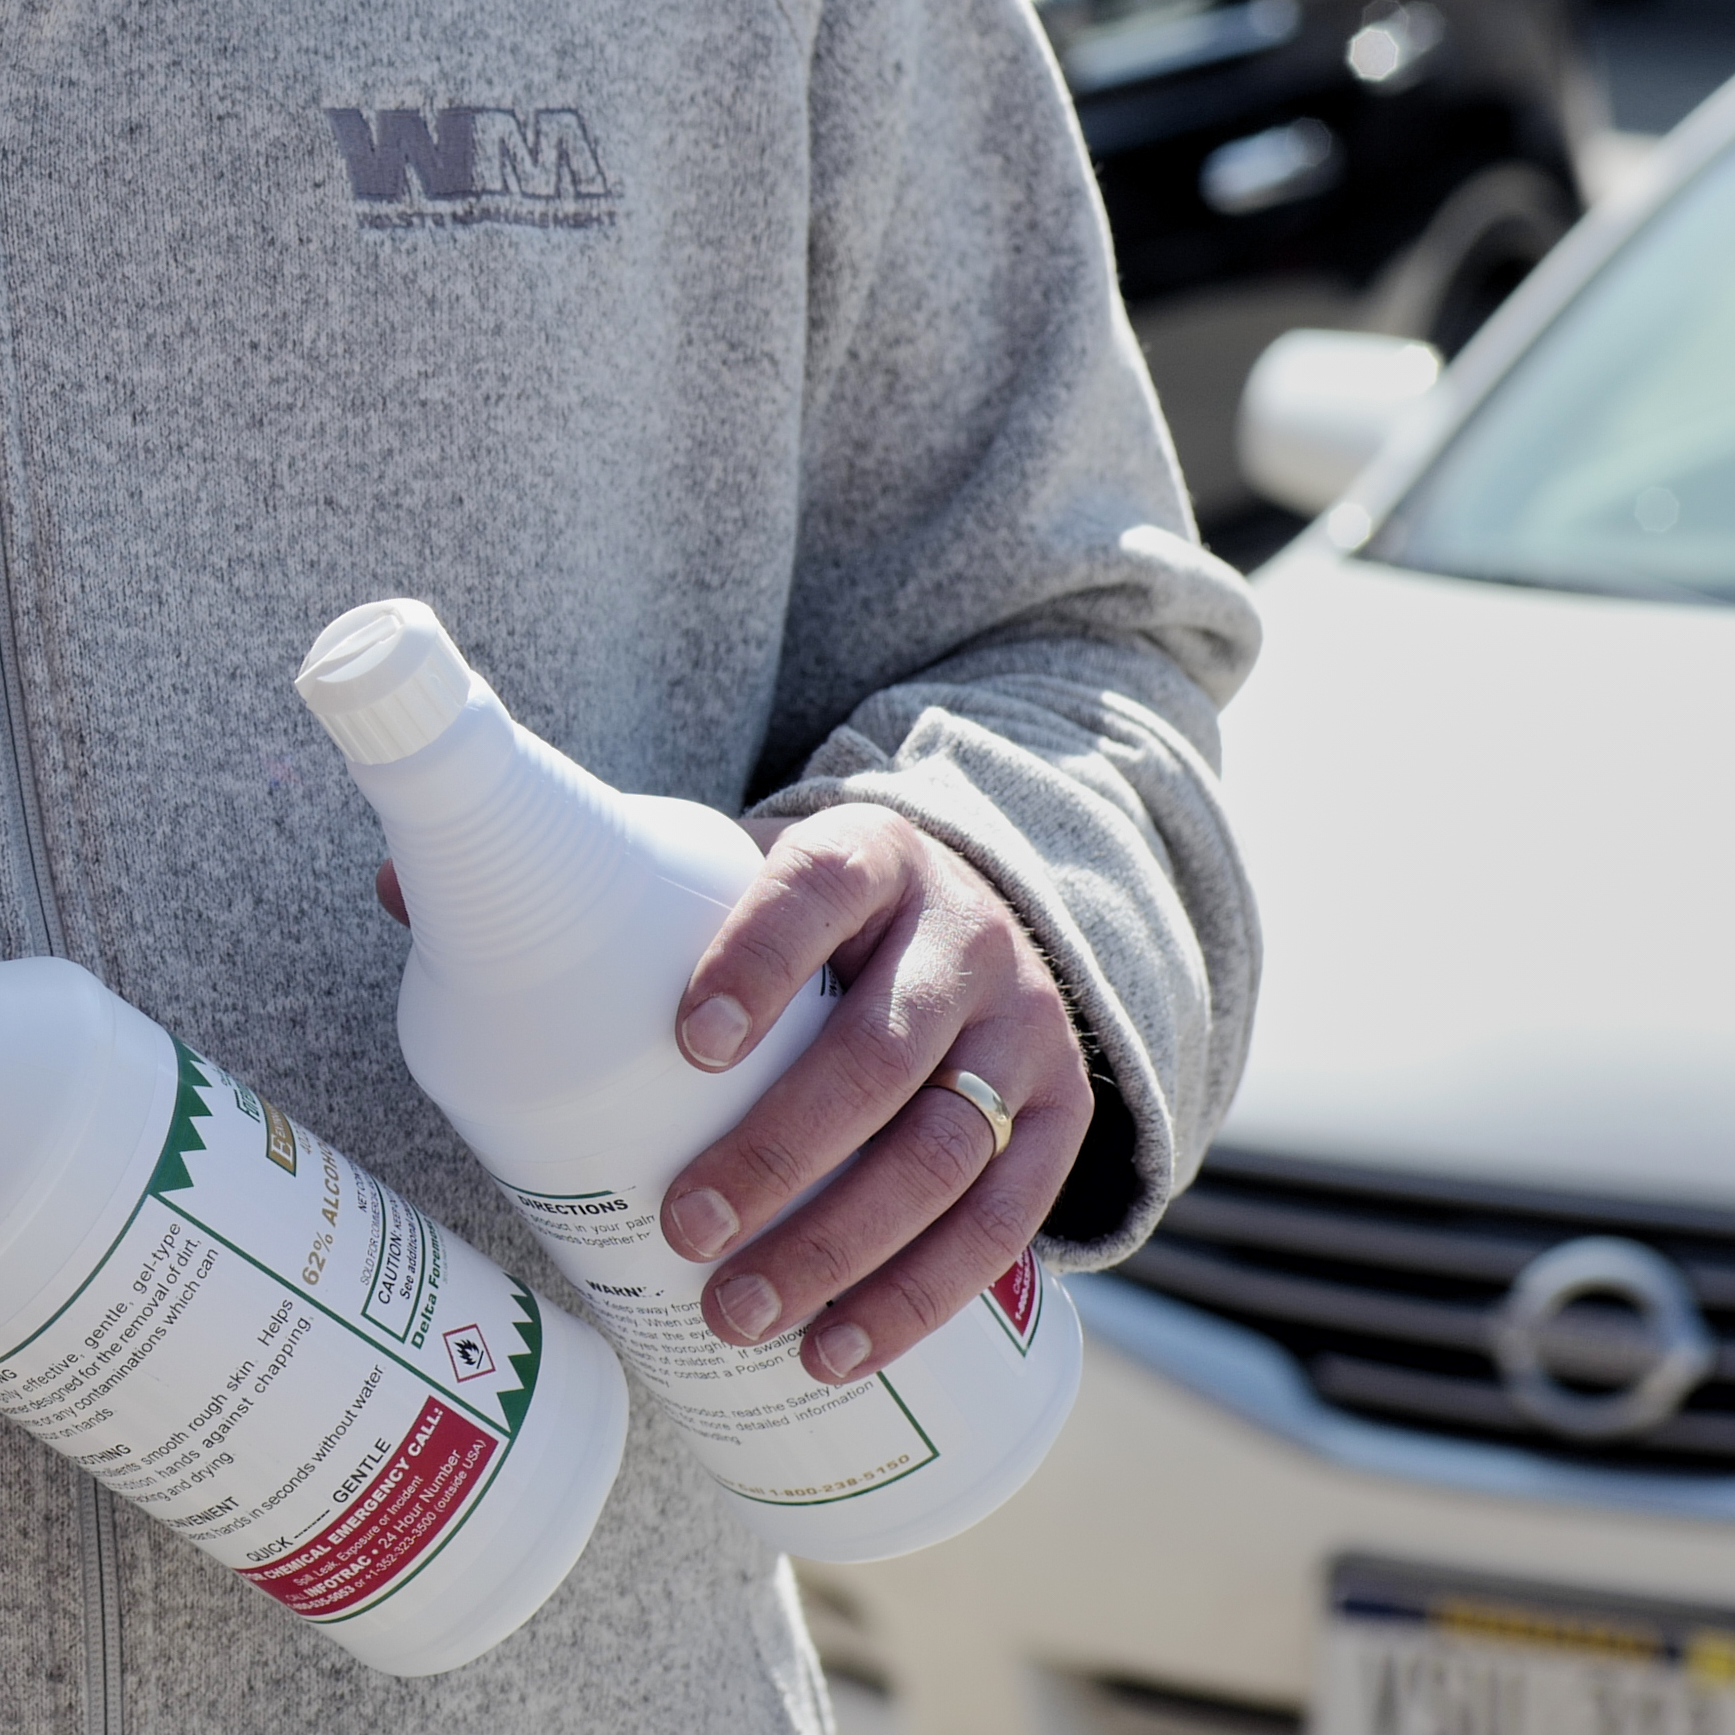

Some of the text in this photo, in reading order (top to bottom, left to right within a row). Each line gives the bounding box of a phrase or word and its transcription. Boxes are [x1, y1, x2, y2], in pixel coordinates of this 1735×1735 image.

[302, 1138, 341, 1286] 62% ALCOHO
[517, 1194, 629, 1216] DIRECTIONS
[574, 1221, 587, 1233] in
[590, 1221, 620, 1235] your
[378, 1229, 403, 1305] CAUTION:
[405, 1220, 418, 1274] additional
[582, 1234, 638, 1248] together
[23, 1352, 86, 1393] effective,
[84, 1301, 135, 1350] gentle,
[132, 1222, 181, 1295] gel-type
[399, 1275, 415, 1300] See
[636, 1306, 668, 1316] away
[30, 1369, 84, 1411] designed
[79, 1360, 102, 1380] for
[96, 1343, 123, 1365] the
[119, 1283, 170, 1344] removal
[167, 1264, 182, 1286] of
[55, 1405, 78, 1422] any
[74, 1325, 167, 1411] contaminations
[162, 1281, 201, 1328] which
[196, 1248, 219, 1280] can
[411, 1294, 437, 1350] Delta
[662, 1331, 685, 1341] the
[140, 1430, 190, 1466] smooth
[187, 1392, 229, 1432] rough
[256, 1299, 294, 1347] Helps
[674, 1369, 720, 1380] contact
[723, 1369, 734, 1378] a
[736, 1354, 784, 1375] Poison
[735, 1416, 791, 1432] detailed
[794, 1379, 875, 1422] information
[762, 1401, 786, 1415] the
[786, 1384, 830, 1409] Safety
[59, 1426, 77, 1439] on
[71, 1444, 132, 1466] OOTHING
[157, 1449, 202, 1480] hands
[201, 1396, 255, 1449] against
[167, 1479, 193, 1498] and
[212, 1515, 252, 1538] hands
[247, 1506, 266, 1520] in
[260, 1462, 316, 1511] seconds
[311, 1408, 358, 1463] without
[265, 1543, 332, 1581] CHEMICAL
[327, 1456, 411, 1545] EMERGENCY
[407, 1407, 444, 1457] CALL:
[769, 1453, 911, 1498] 1-800-238-5150
[167, 1496, 241, 1527] ONVENIENT
[245, 1438, 392, 1563] QUICK GENTLE
[304, 1555, 372, 1598] INFOTRAC
[377, 1531, 398, 1550] 24
[393, 1503, 425, 1534] Hour
[418, 1448, 462, 1504] Number
[336, 1524, 381, 1563] Exposure
[378, 1511, 391, 1526] or
[386, 1474, 424, 1516] Incident
[354, 1577, 366, 1588] or
[433, 1469, 468, 1513] (outside
[462, 1438, 488, 1471] USA)
